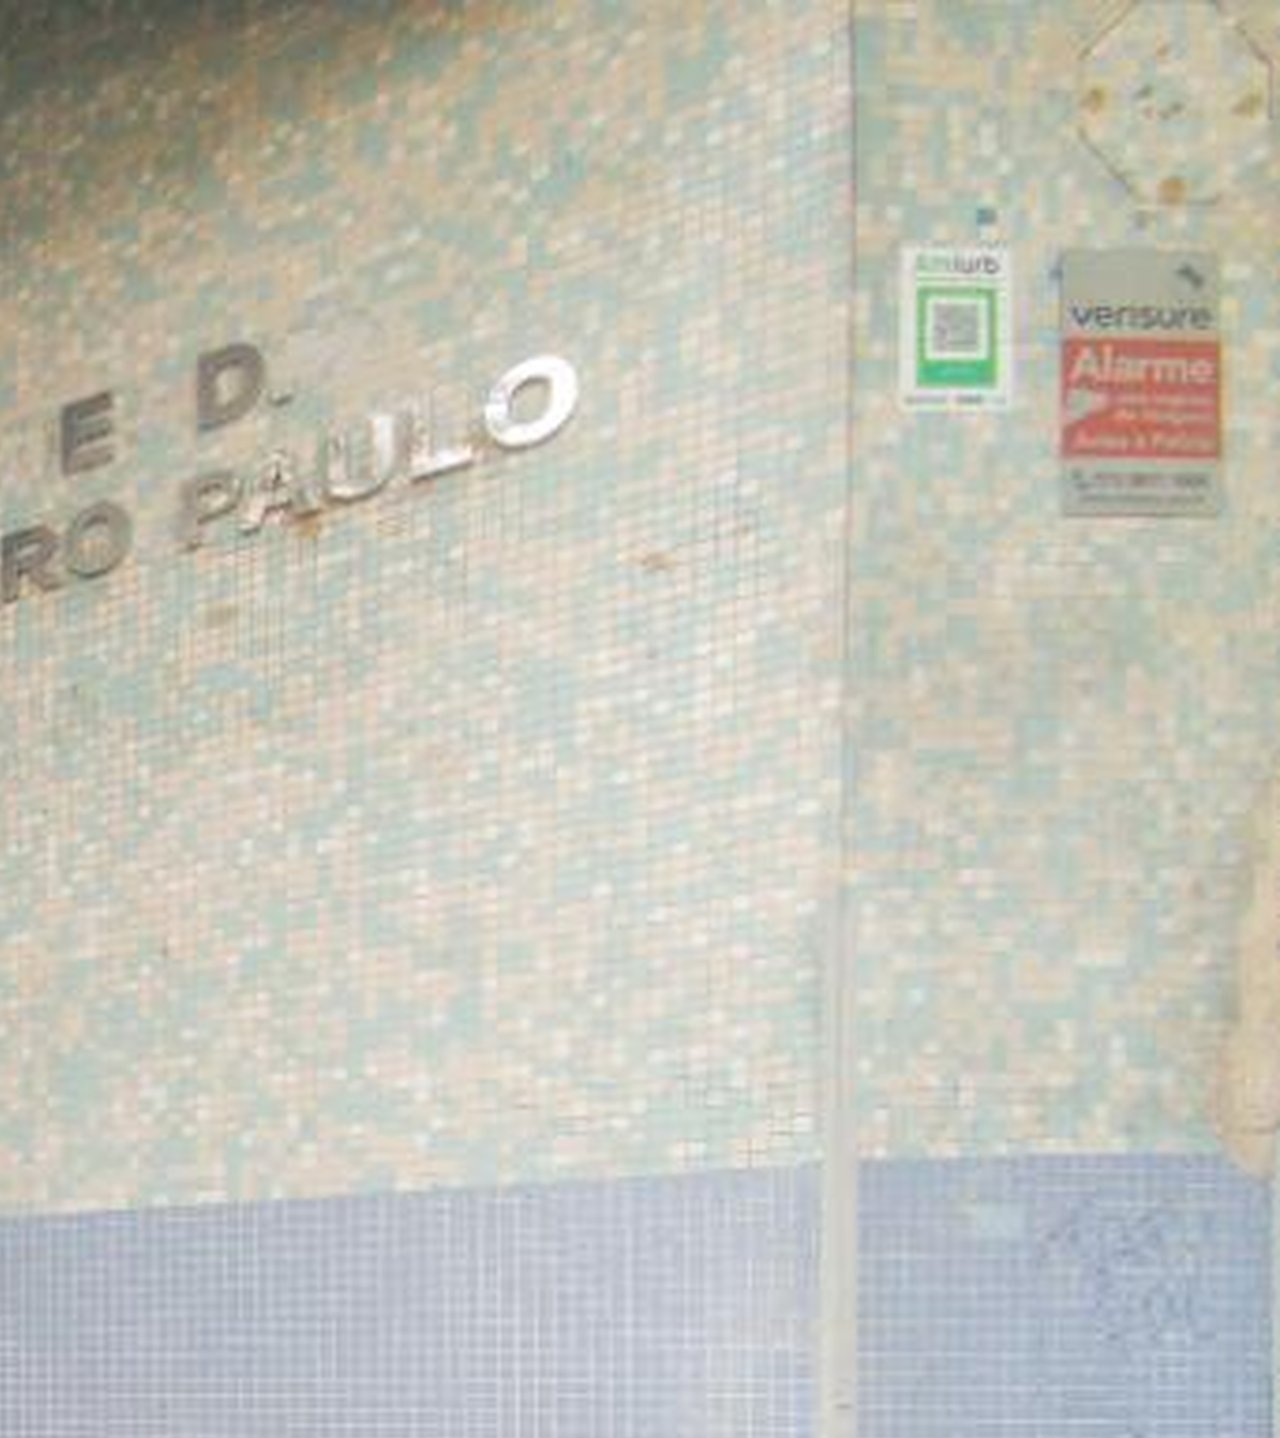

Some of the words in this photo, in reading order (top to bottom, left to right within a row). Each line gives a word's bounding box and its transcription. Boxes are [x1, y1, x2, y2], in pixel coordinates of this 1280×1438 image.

[1071, 303, 1214, 330] verisure
[1069, 342, 1216, 384] Alarme
[177, 354, 581, 553] PAULO
